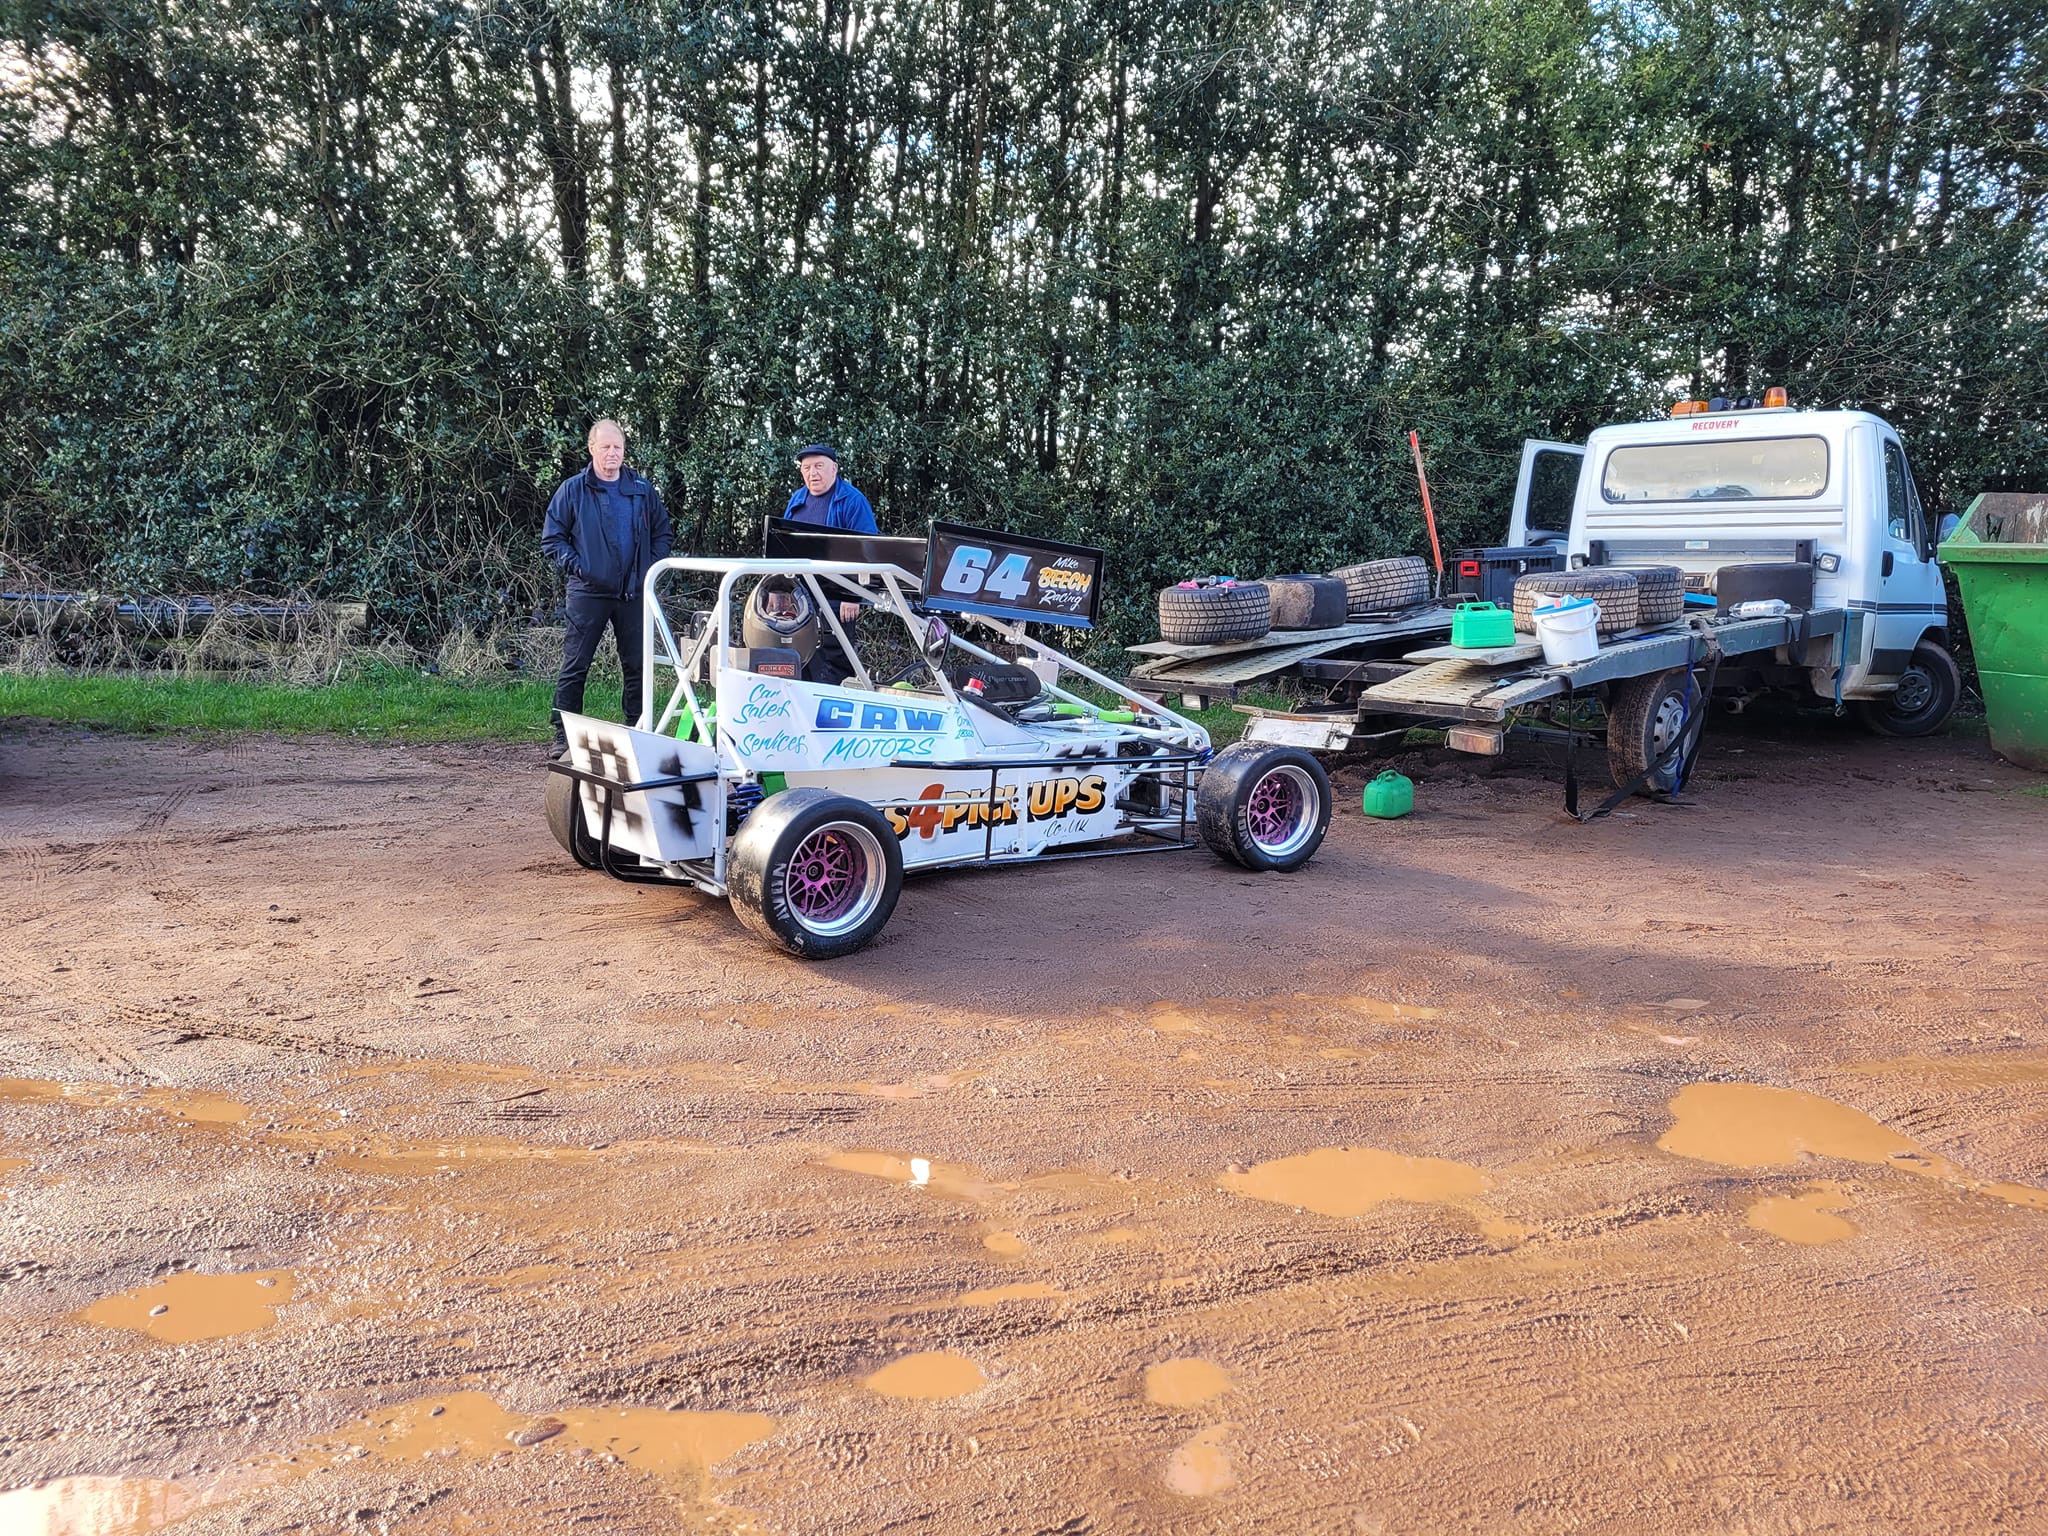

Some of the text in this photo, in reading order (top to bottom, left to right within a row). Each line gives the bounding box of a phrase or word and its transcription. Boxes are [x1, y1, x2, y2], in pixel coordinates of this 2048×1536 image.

[1692, 420, 1739, 430] RECOVERY
[941, 545, 1032, 600] 64
[1052, 556, 1079, 569] Mike
[1038, 567, 1092, 593] BEECH
[1038, 589, 1083, 611] Racing
[749, 683, 781, 703] Car
[733, 700, 791, 724] Sales
[815, 698, 943, 731] CRW
[738, 729, 808, 757] Services
[822, 737, 936, 764] MOTORS
[770, 862, 790, 921] AVON
